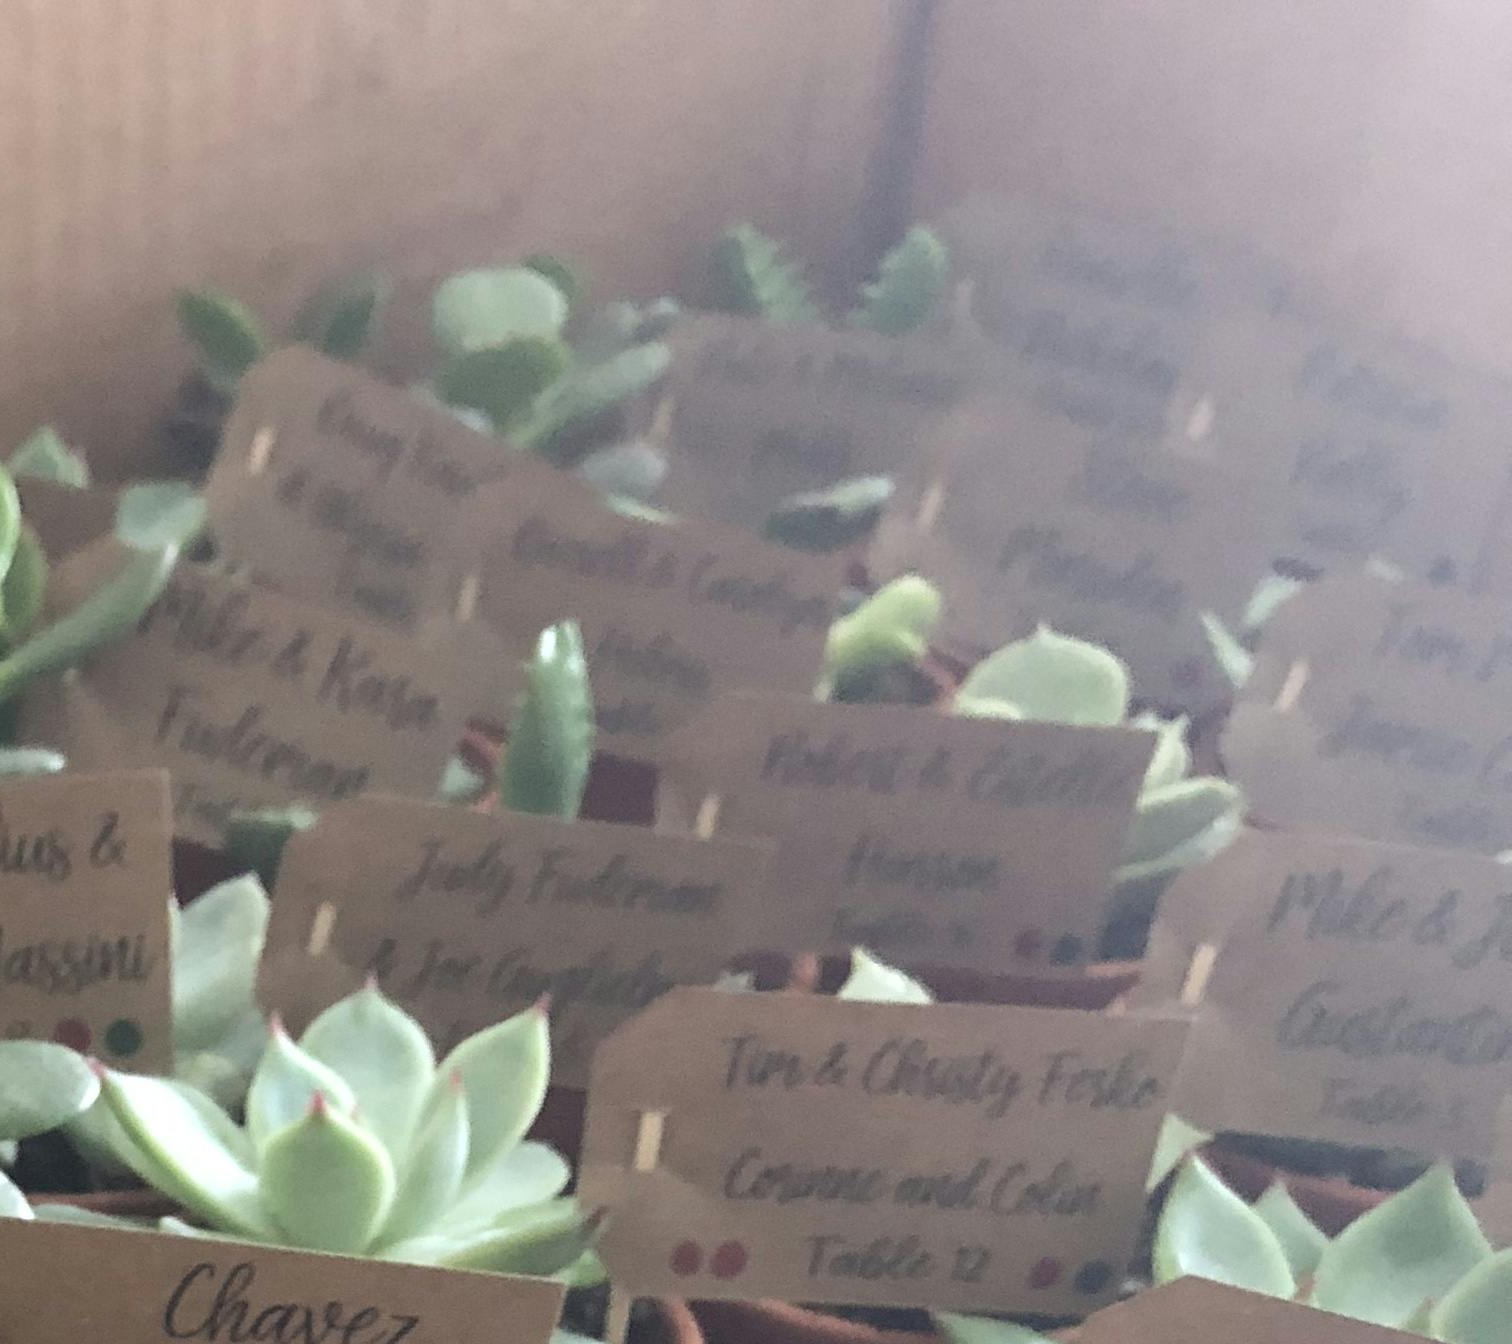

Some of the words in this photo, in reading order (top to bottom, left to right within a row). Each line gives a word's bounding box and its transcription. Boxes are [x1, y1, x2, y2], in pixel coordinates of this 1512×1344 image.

[89, 810, 127, 866] &
[815, 1041, 848, 1087] &
[807, 1235, 936, 1279] Table
